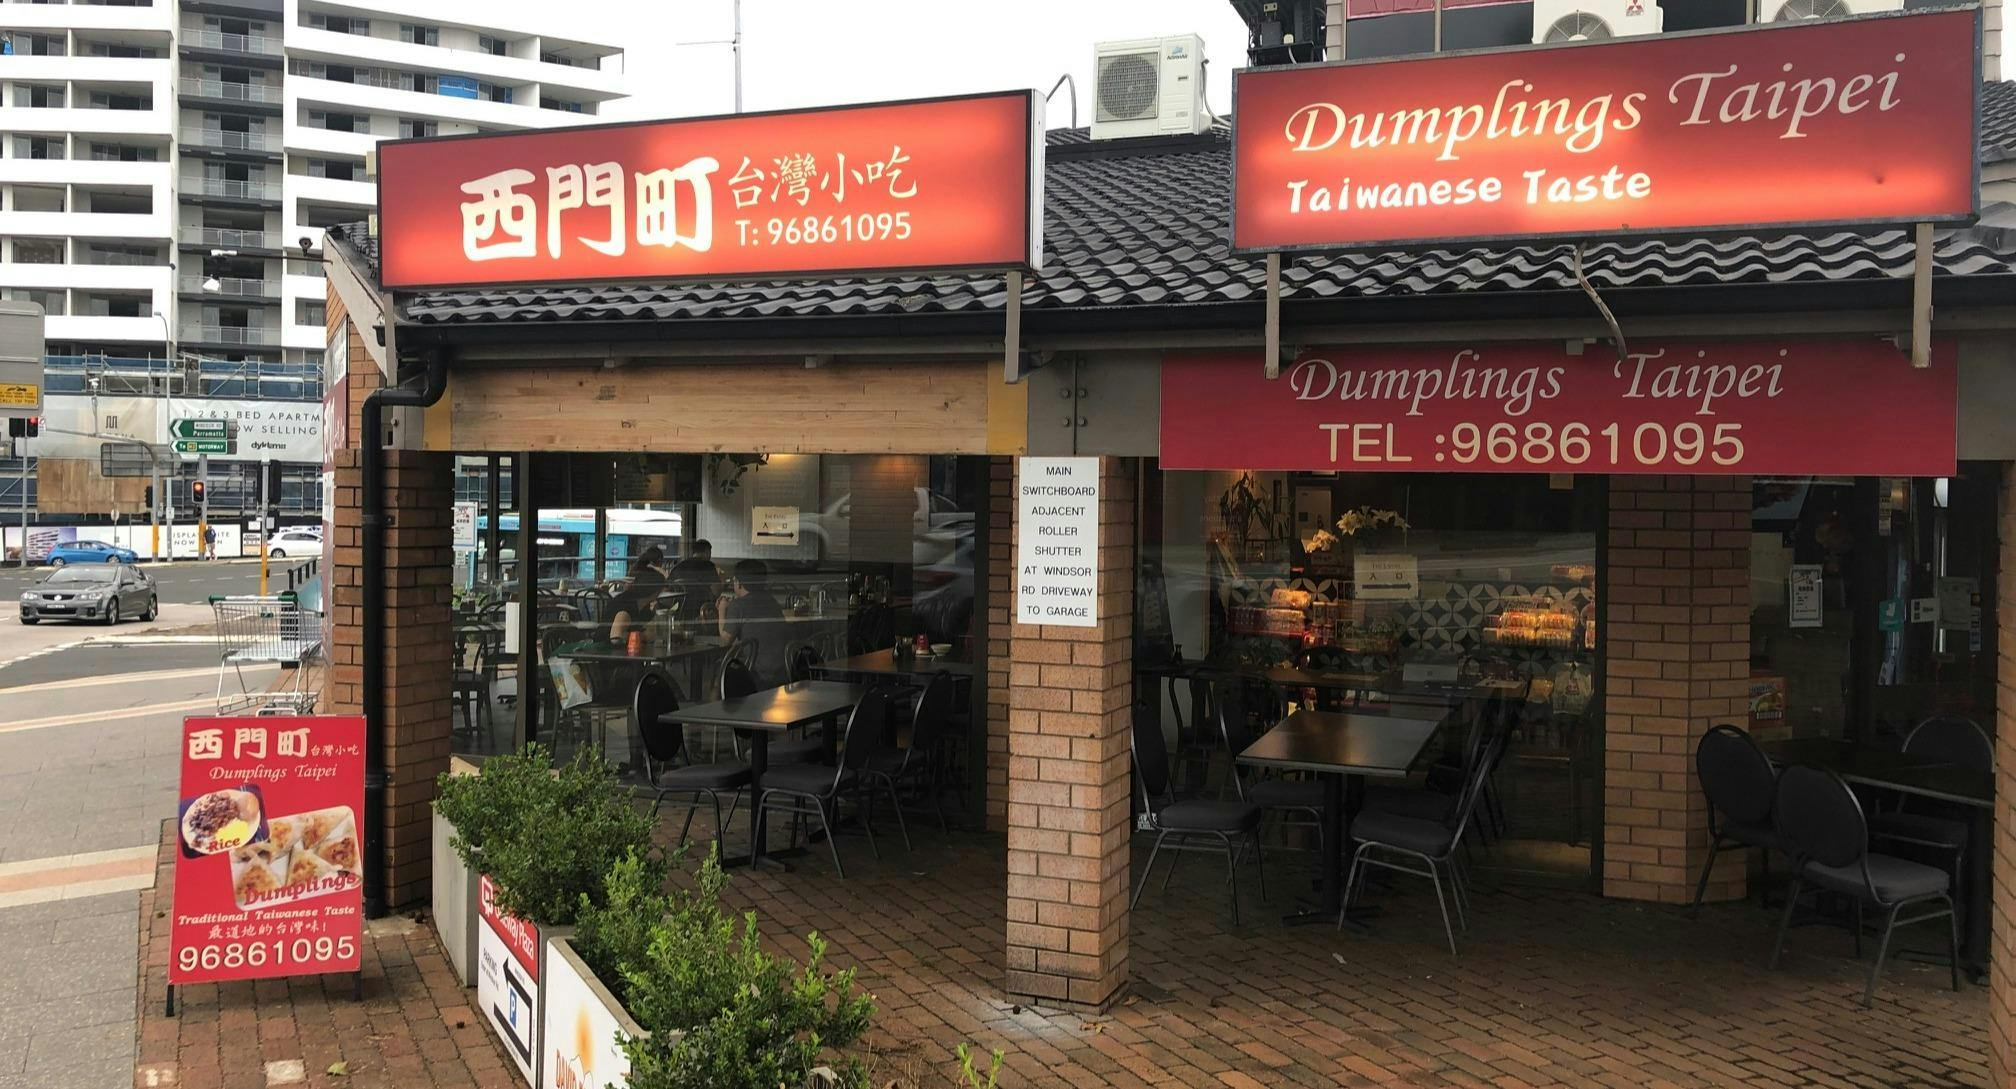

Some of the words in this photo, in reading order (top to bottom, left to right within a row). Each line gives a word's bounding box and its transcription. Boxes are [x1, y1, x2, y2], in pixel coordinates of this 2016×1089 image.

[1285, 80, 1646, 160] Dumplings
[1669, 53, 1905, 138] Taipei
[727, 145, 918, 210] 台灣小吃
[1287, 174, 1502, 213] Taiwanese
[1522, 165, 1652, 205] Taste
[460, 157, 720, 261] 西門町
[735, 219, 760, 246] T:
[766, 212, 912, 245] 96861095
[1291, 349, 1565, 416] Dumplings
[1614, 348, 1788, 415] Taipei
[236, 411, 261, 419] BED
[236, 425, 254, 433] OW
[262, 426, 318, 435] SELLING
[1319, 423, 1413, 463] TEL
[1046, 467, 1072, 476] MAIN
[1022, 486, 1096, 496] SWITCHBOARD
[1031, 506, 1086, 516] ADJACENT
[1038, 526, 1078, 536] ROLLER
[1034, 546, 1082, 556] SHUTTER
[1024, 566, 1037, 575] AT
[1044, 566, 1092, 576] WINDSOR
[1021, 586, 1035, 595] RD
[1041, 586, 1093, 596] DRIVEWAY
[1027, 606, 1040, 615] TO
[1047, 606, 1089, 617] GARAGE
[188, 727, 311, 760] 西門町
[310, 744, 360, 757] 台灣小吃
[209, 764, 287, 783] Dumplings
[295, 763, 338, 781] Taipei
[208, 837, 241, 853] Rice
[242, 870, 358, 907] Dumplings
[178, 911, 249, 925] Traditional
[255, 908, 318, 920] Taiwanese
[324, 905, 355, 917] Taste
[179, 936, 355, 972] 96861095
